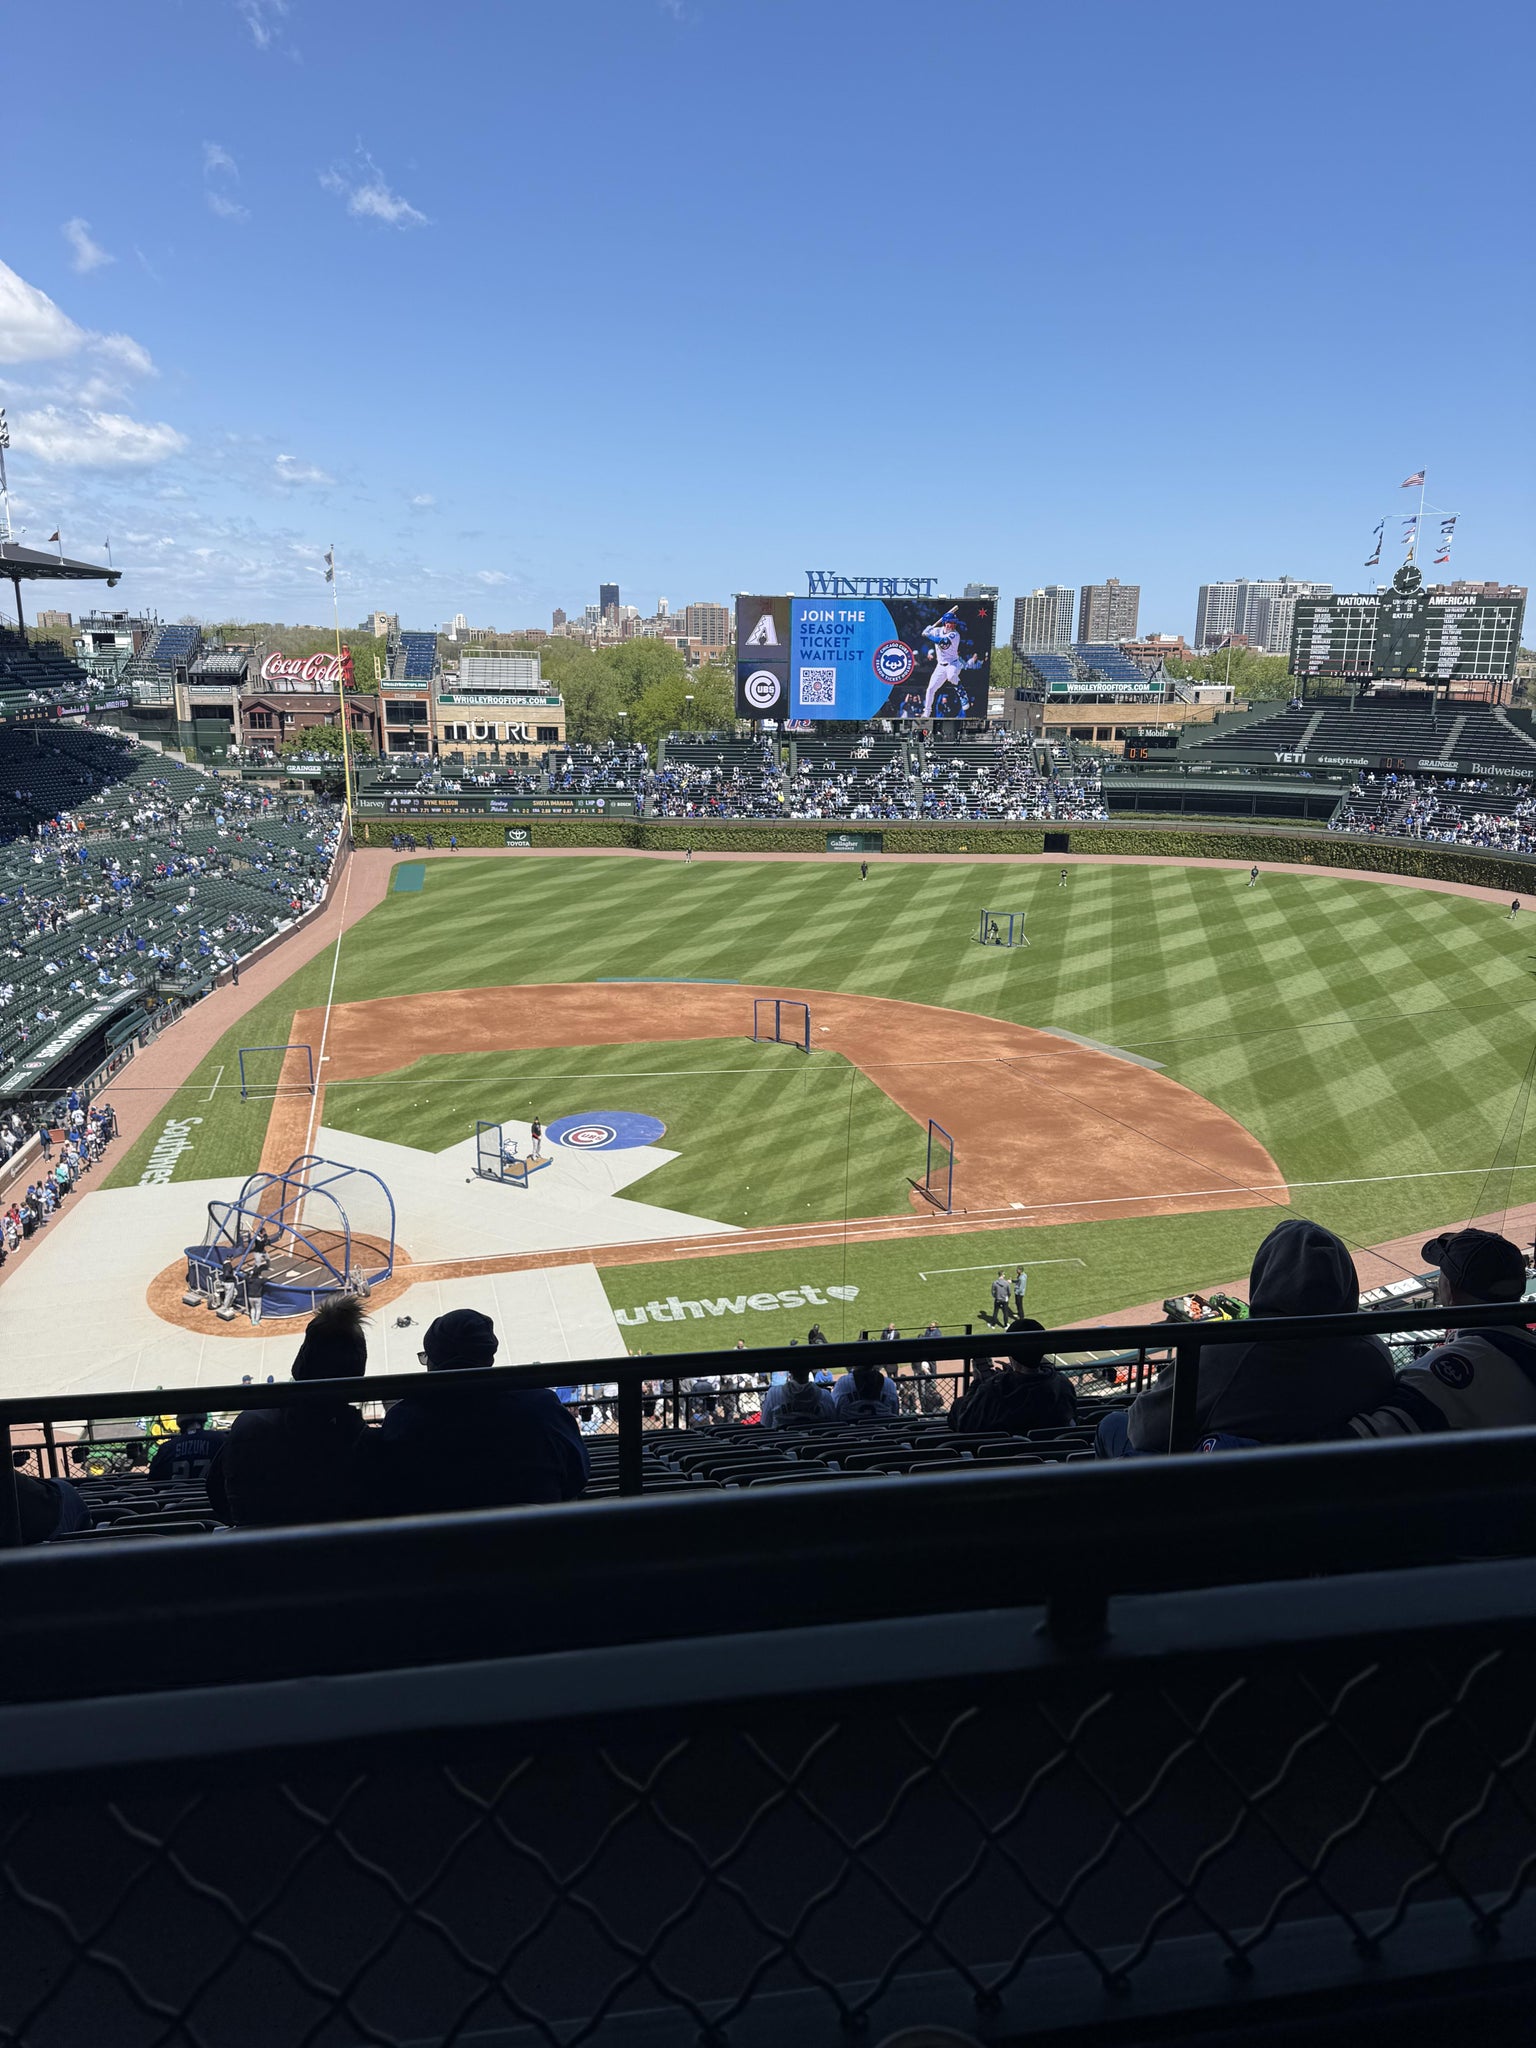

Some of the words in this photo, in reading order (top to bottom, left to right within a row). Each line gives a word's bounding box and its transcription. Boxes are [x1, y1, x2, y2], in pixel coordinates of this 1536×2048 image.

[805, 571, 938, 597] WINTRUST
[1336, 597, 1381, 606] NATIONAL
[1428, 596, 1477, 605] AMERICAN
[800, 610, 834, 622] JOIN
[838, 610, 866, 622] THE
[800, 623, 855, 635] SEASON
[800, 636, 850, 648] TICKET
[879, 643, 899, 654] CHICAGO
[899, 644, 909, 654] CUBS
[800, 650, 865, 661] WAITLIST
[261, 652, 348, 683] Coca-Cola
[876, 659, 886, 678] SEASON
[1067, 683, 1150, 691] WRIGLEYROOFTOPS.COM
[453, 695, 547, 705] WRIGLEYROOFTOPS.COM
[1274, 752, 1307, 763] YETI
[1323, 756, 1369, 765] tastytrade
[1418, 759, 1459, 769] GRAINGER
[360, 800, 386, 808] Harvey
[58, 1013, 101, 1039] CHICAGO
[36, 1040, 70, 1058] CUBS
[138, 1116, 203, 1186] Southwes
[614, 1285, 829, 1326] uthwest
[175, 1439, 210, 1458] SUZUKI
